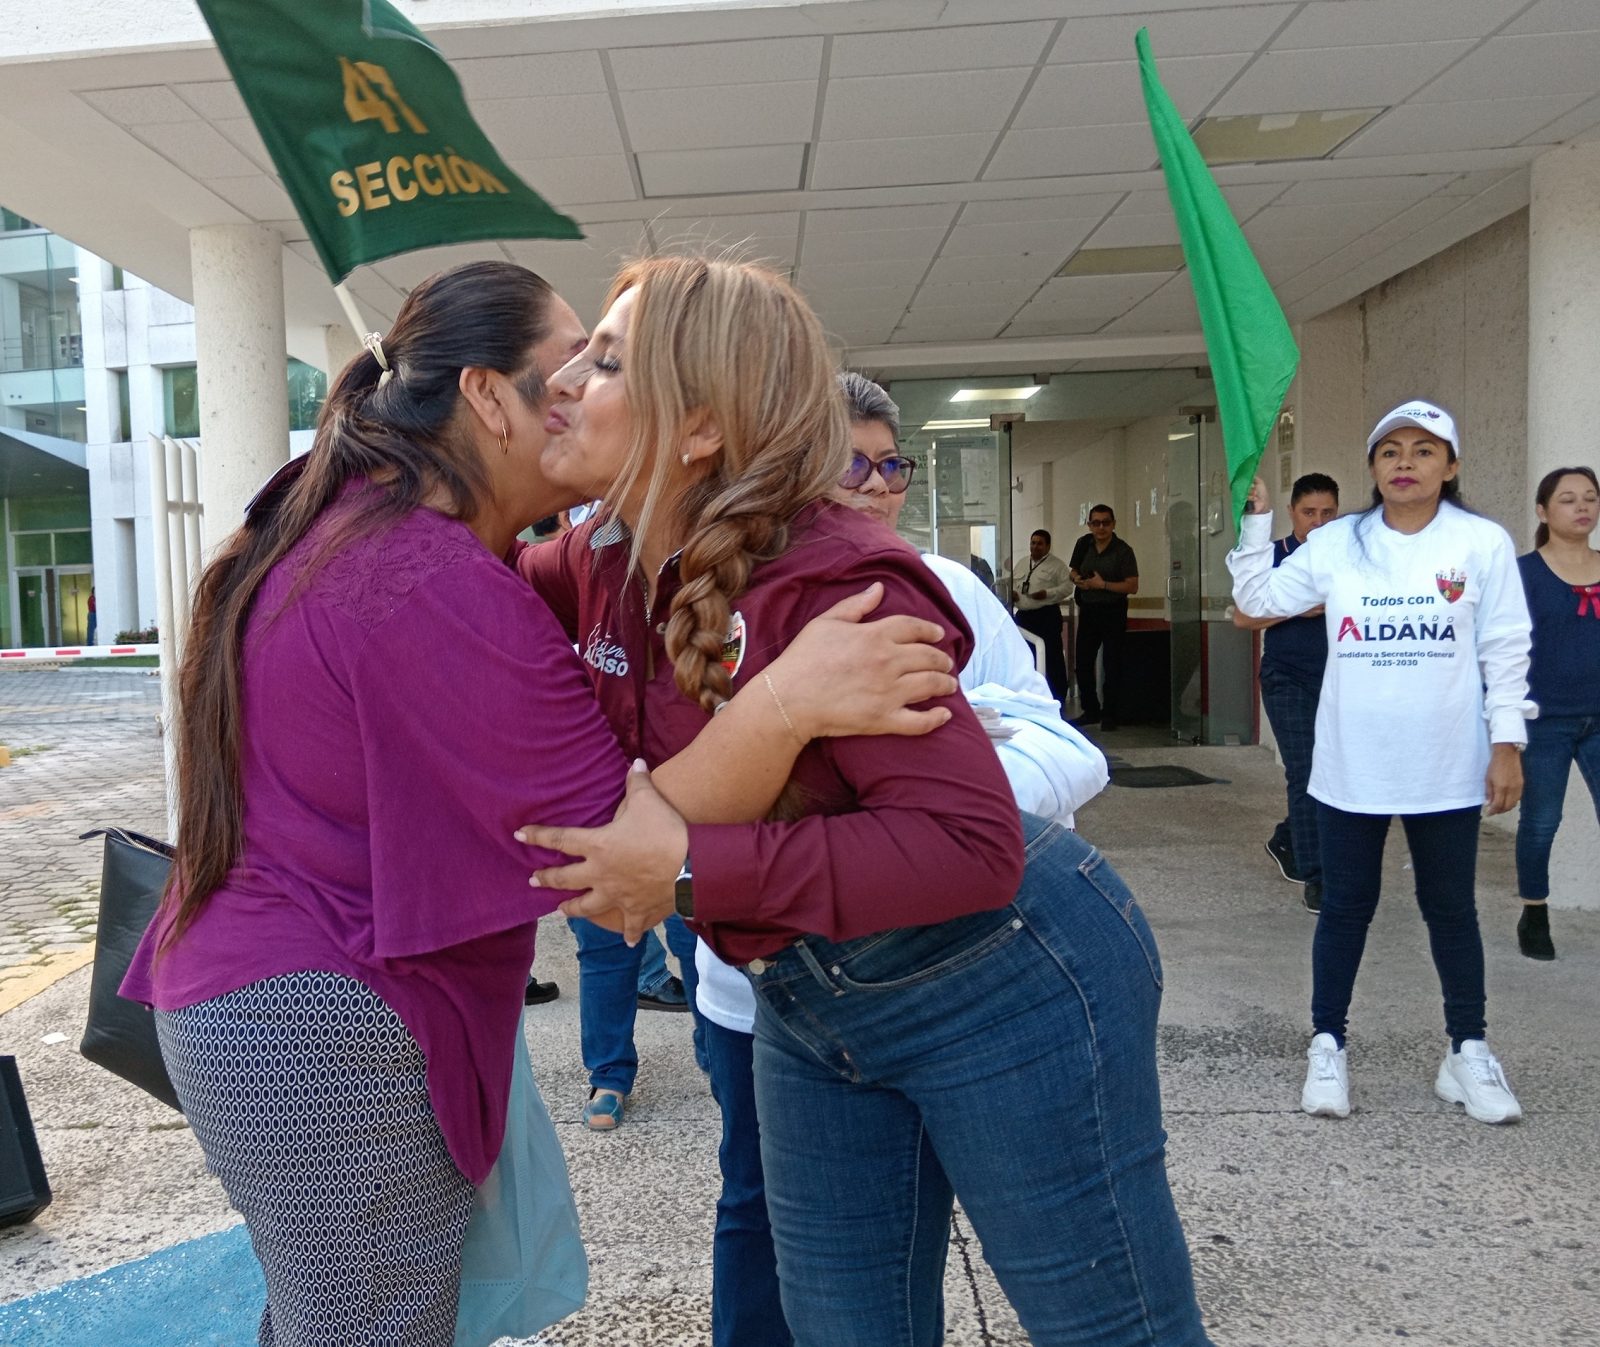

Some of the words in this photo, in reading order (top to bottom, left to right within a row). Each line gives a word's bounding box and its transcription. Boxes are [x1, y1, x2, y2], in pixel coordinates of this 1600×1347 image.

[1361, 596, 1404, 607] Todos
[1407, 596, 1435, 605] con
[1364, 614, 1455, 624] RICARDO
[1337, 616, 1456, 642] ALDANA
[1381, 650, 1425, 658] Secretario
[1427, 651, 1455, 659] General
[1371, 659, 1418, 667] 2025-2030
